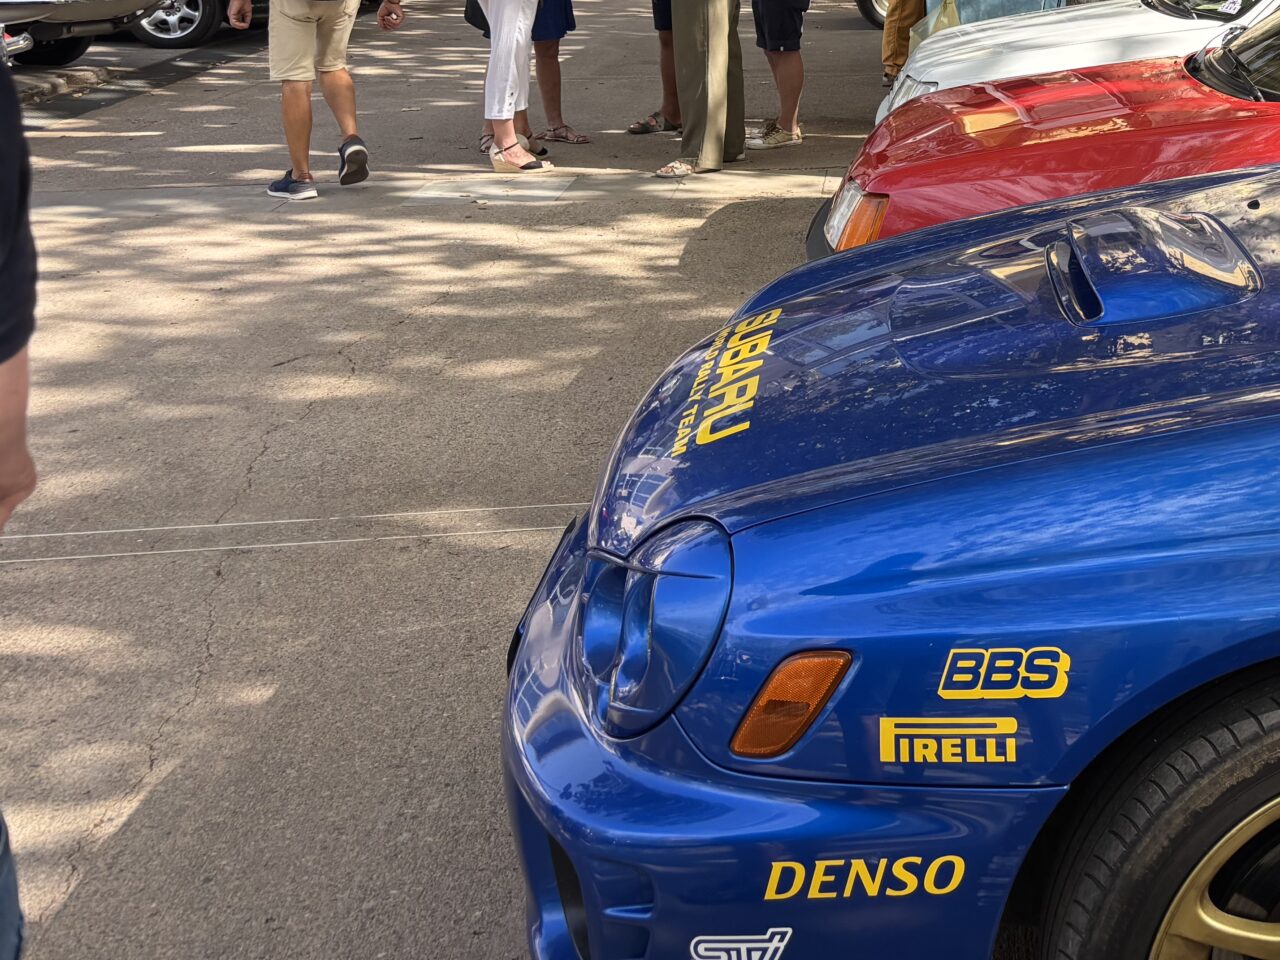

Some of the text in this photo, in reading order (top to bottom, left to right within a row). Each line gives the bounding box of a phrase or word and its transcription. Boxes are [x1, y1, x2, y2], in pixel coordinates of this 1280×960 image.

[688, 360, 715, 402] RALLY
[696, 308, 783, 445] SUBARU
[671, 404, 698, 458] TEAM
[937, 646, 1071, 700] BBS
[879, 717, 1018, 763] PIRELLI
[763, 855, 966, 901] DENSO
